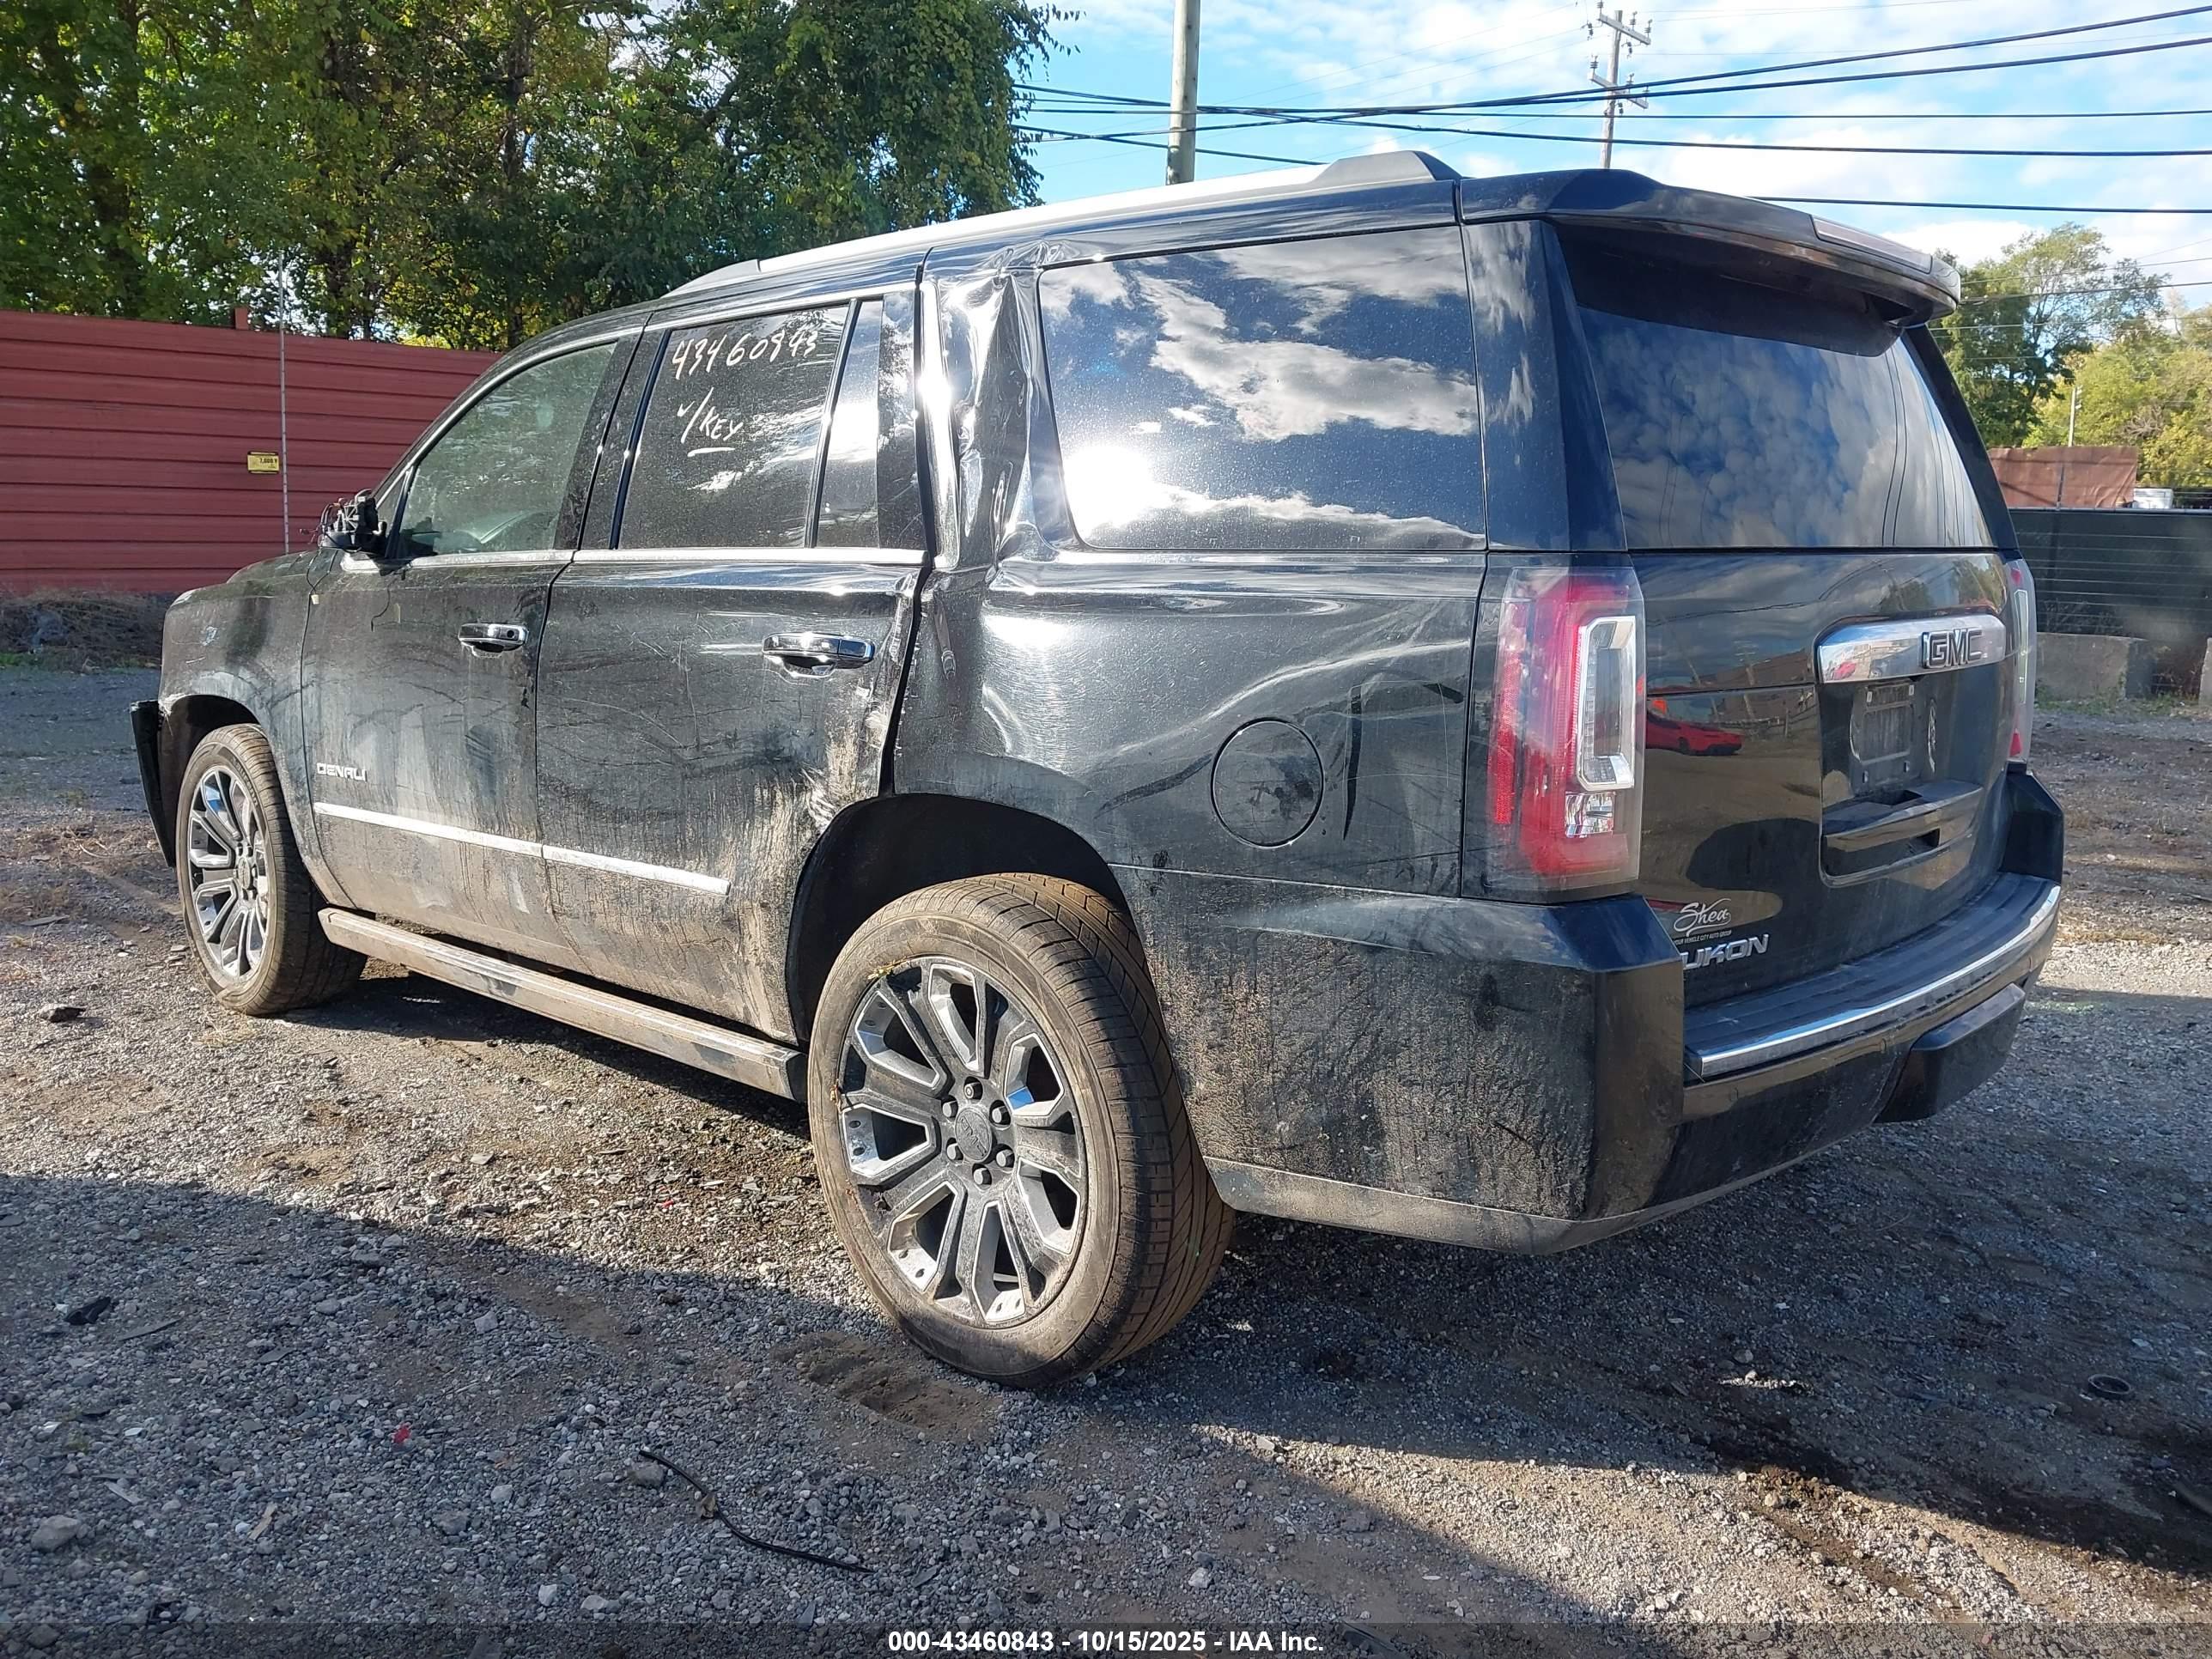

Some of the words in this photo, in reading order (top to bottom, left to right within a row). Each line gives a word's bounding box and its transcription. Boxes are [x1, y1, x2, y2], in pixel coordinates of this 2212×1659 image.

[1922, 626, 1984, 670] GMC
[316, 762, 368, 782] DENALI
[1674, 897, 1732, 937] Shea
[1680, 933, 1770, 970] UKON
